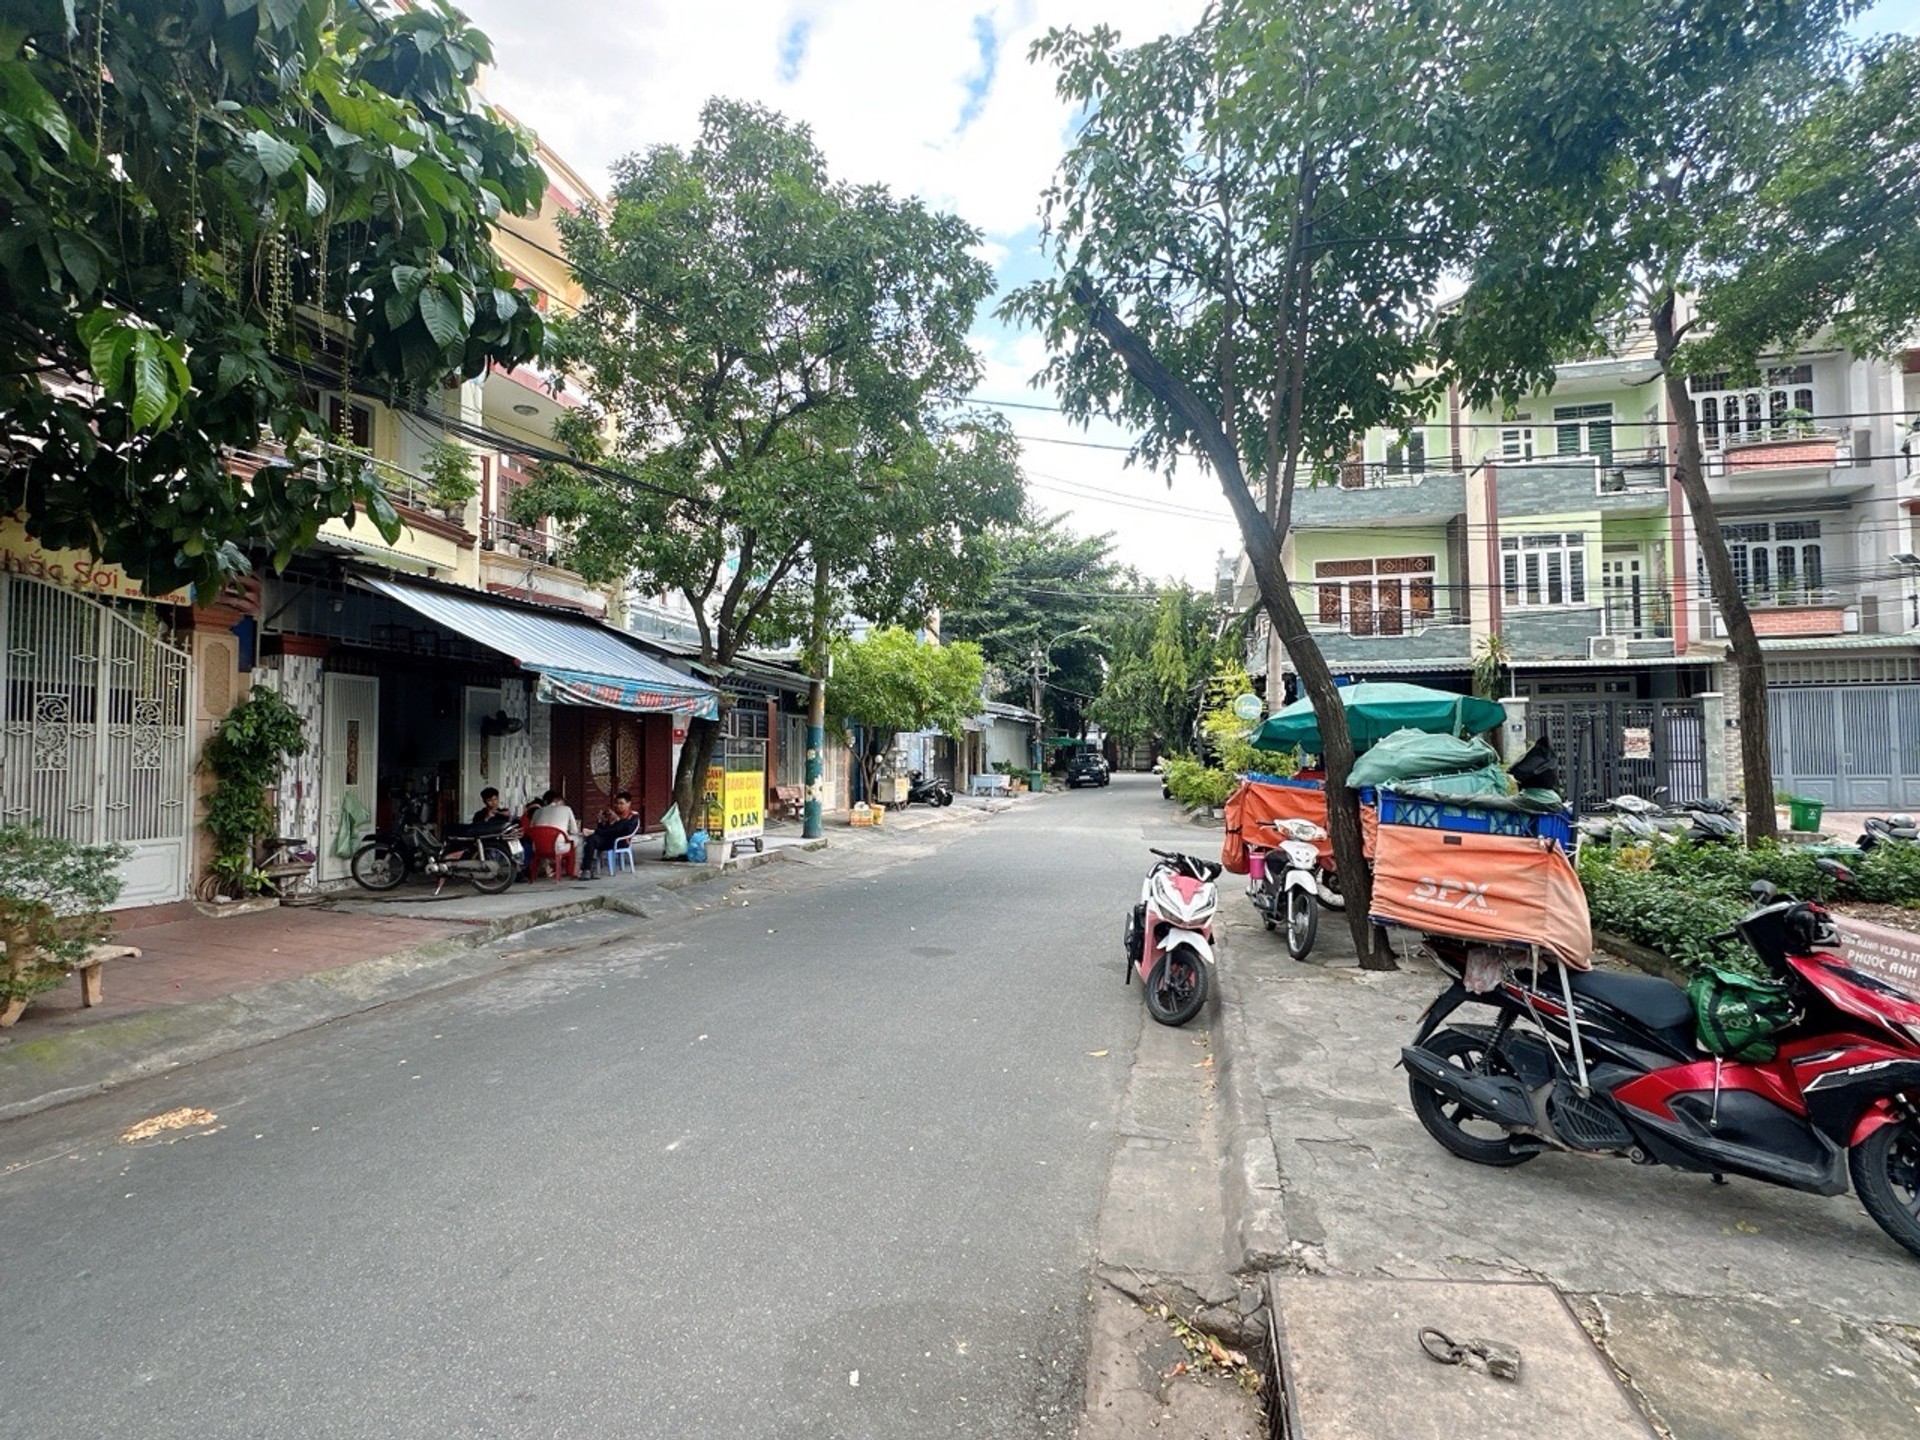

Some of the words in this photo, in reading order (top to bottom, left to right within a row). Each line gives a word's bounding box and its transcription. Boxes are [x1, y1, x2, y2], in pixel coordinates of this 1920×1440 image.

[73, 561, 118, 592] Sợi
[740, 811, 759, 827] LAN
[1889, 962, 1918, 979] ANH
